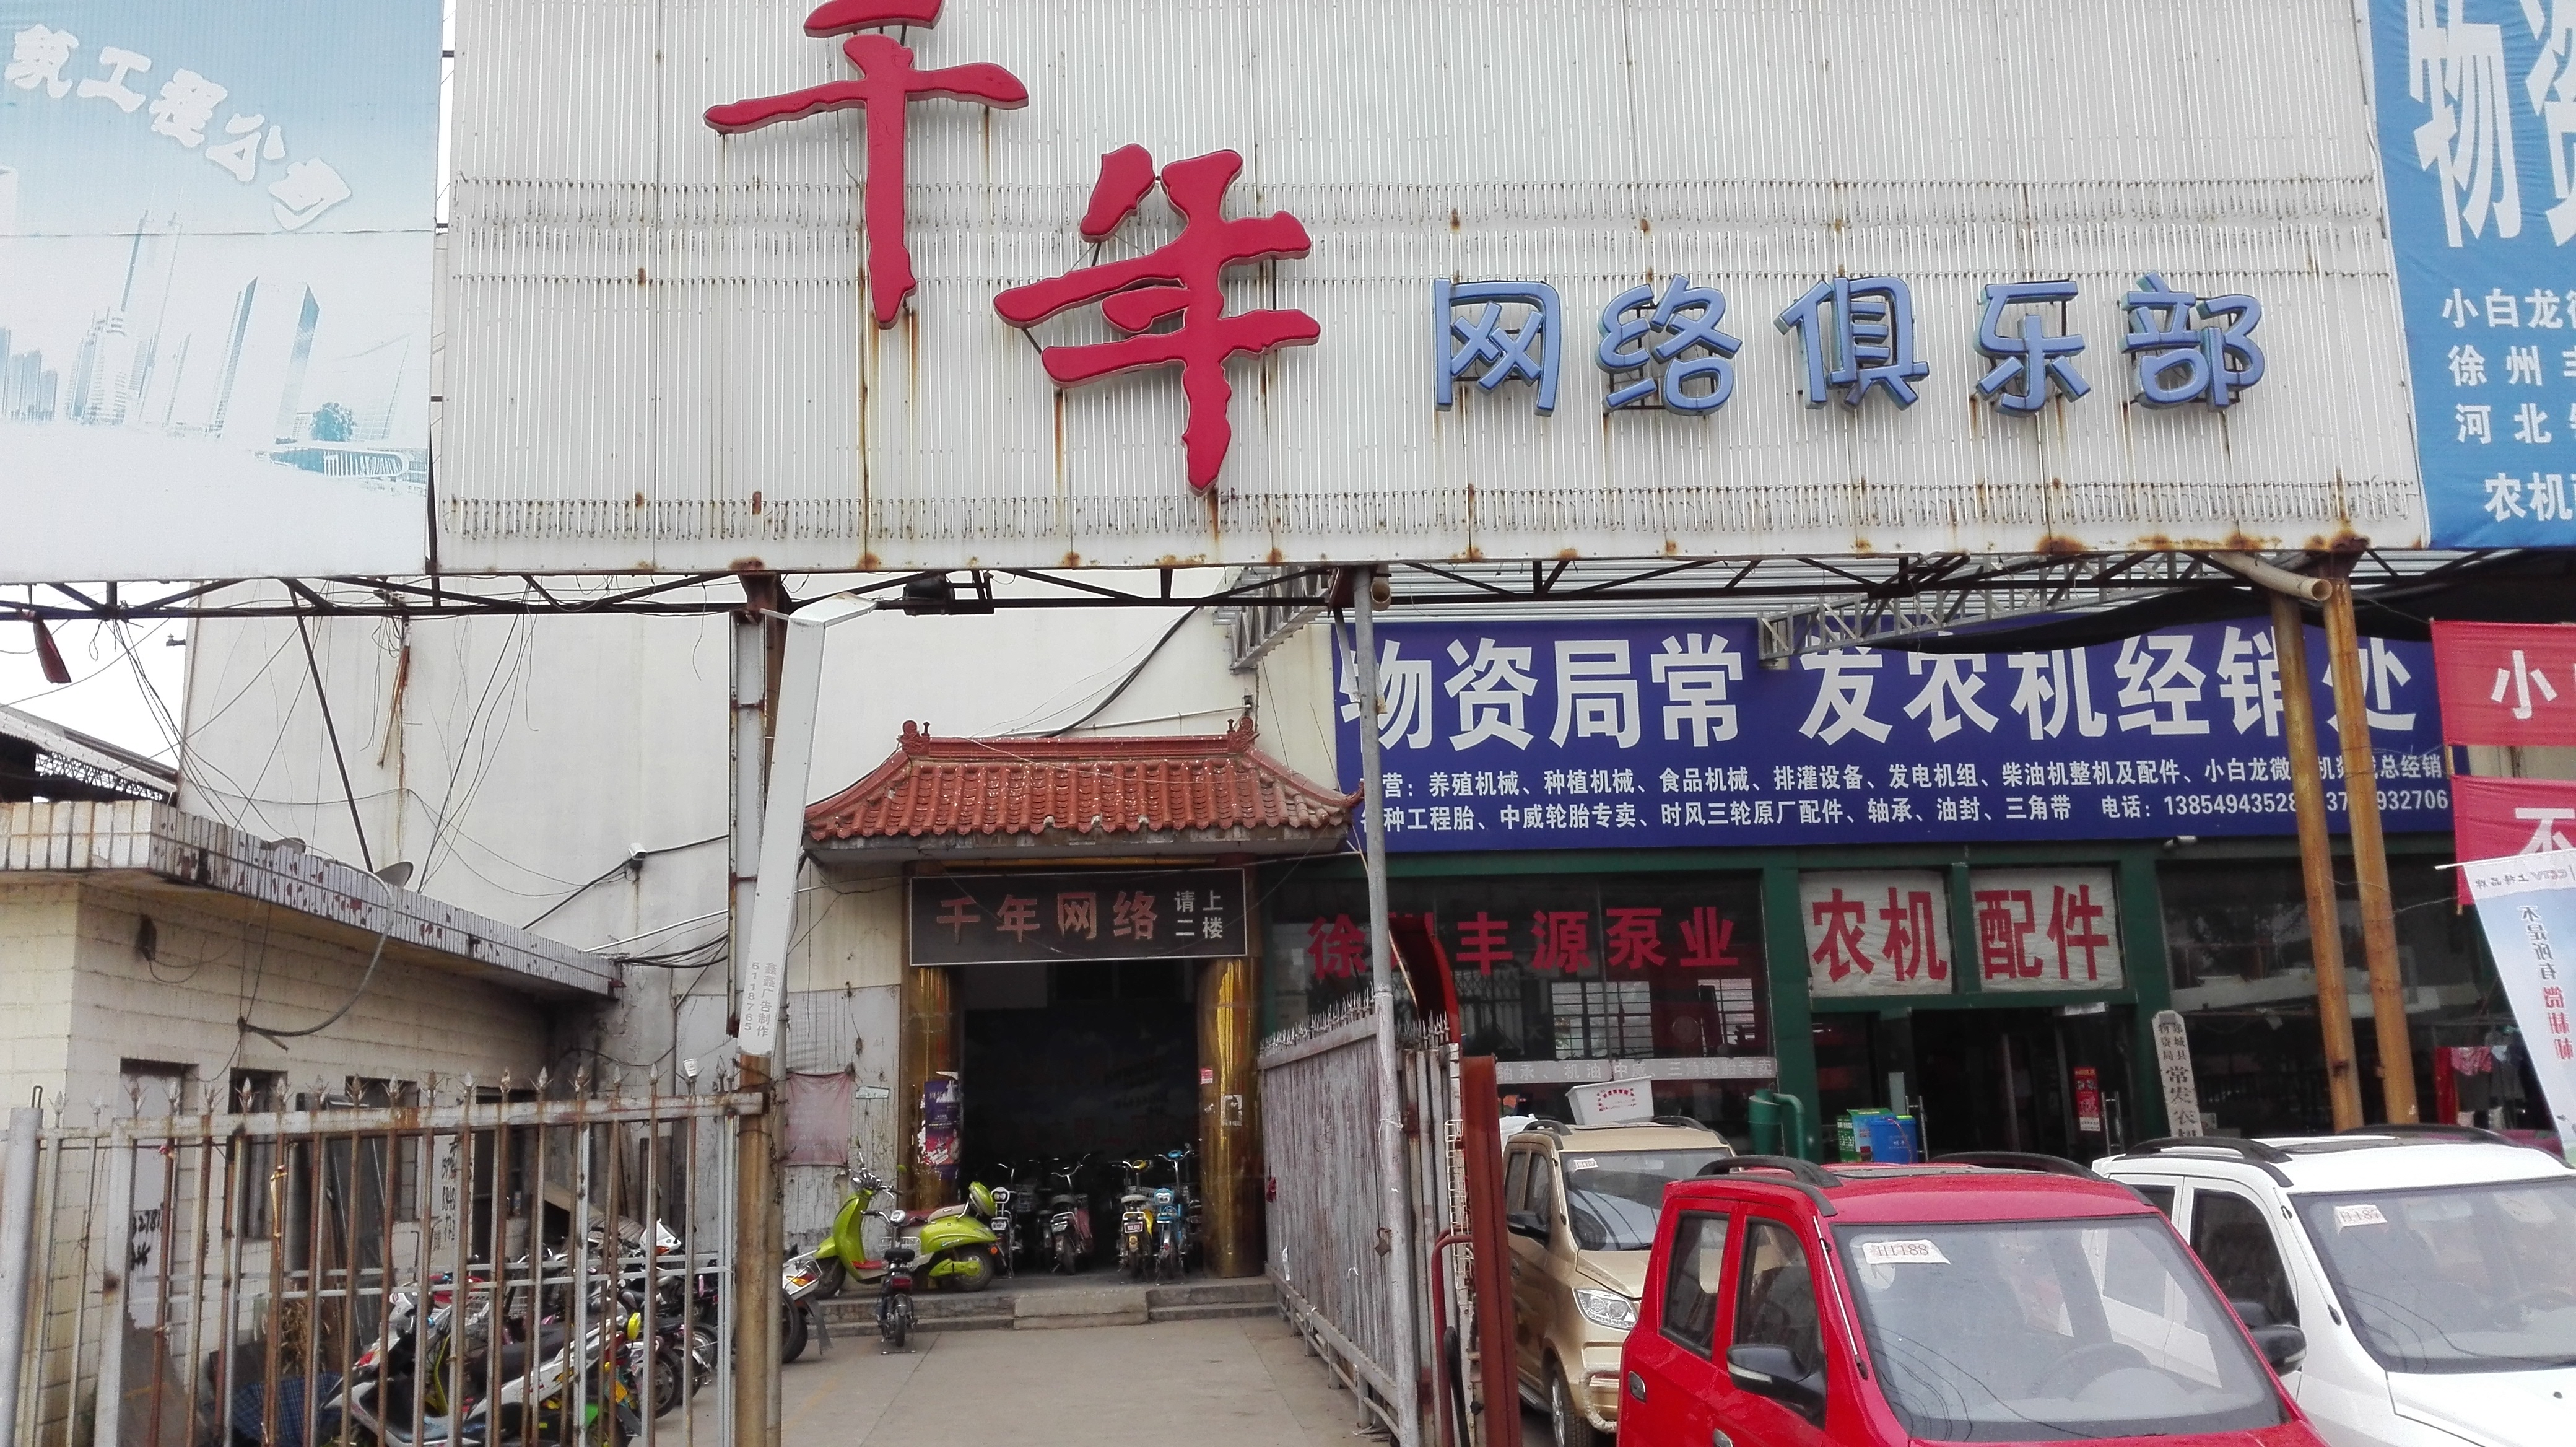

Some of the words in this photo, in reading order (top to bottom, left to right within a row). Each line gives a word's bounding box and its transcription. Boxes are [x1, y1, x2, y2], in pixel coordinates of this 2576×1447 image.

[703, 0, 1320, 494] 千年
[2442, 287, 2576, 329] 小白龙
[1432, 270, 2265, 417] 网络俱乐部
[2455, 403, 2576, 445] 河北
[2484, 473, 2576, 523] 农机
[2491, 650, 2576, 720] 小
[2326, 790, 2448, 811] 37932706
[936, 891, 1158, 945] 千年网络
[1812, 887, 1947, 982] 农机
[1974, 884, 2110, 981] 配件
[744, 962, 760, 1031] 6118765
